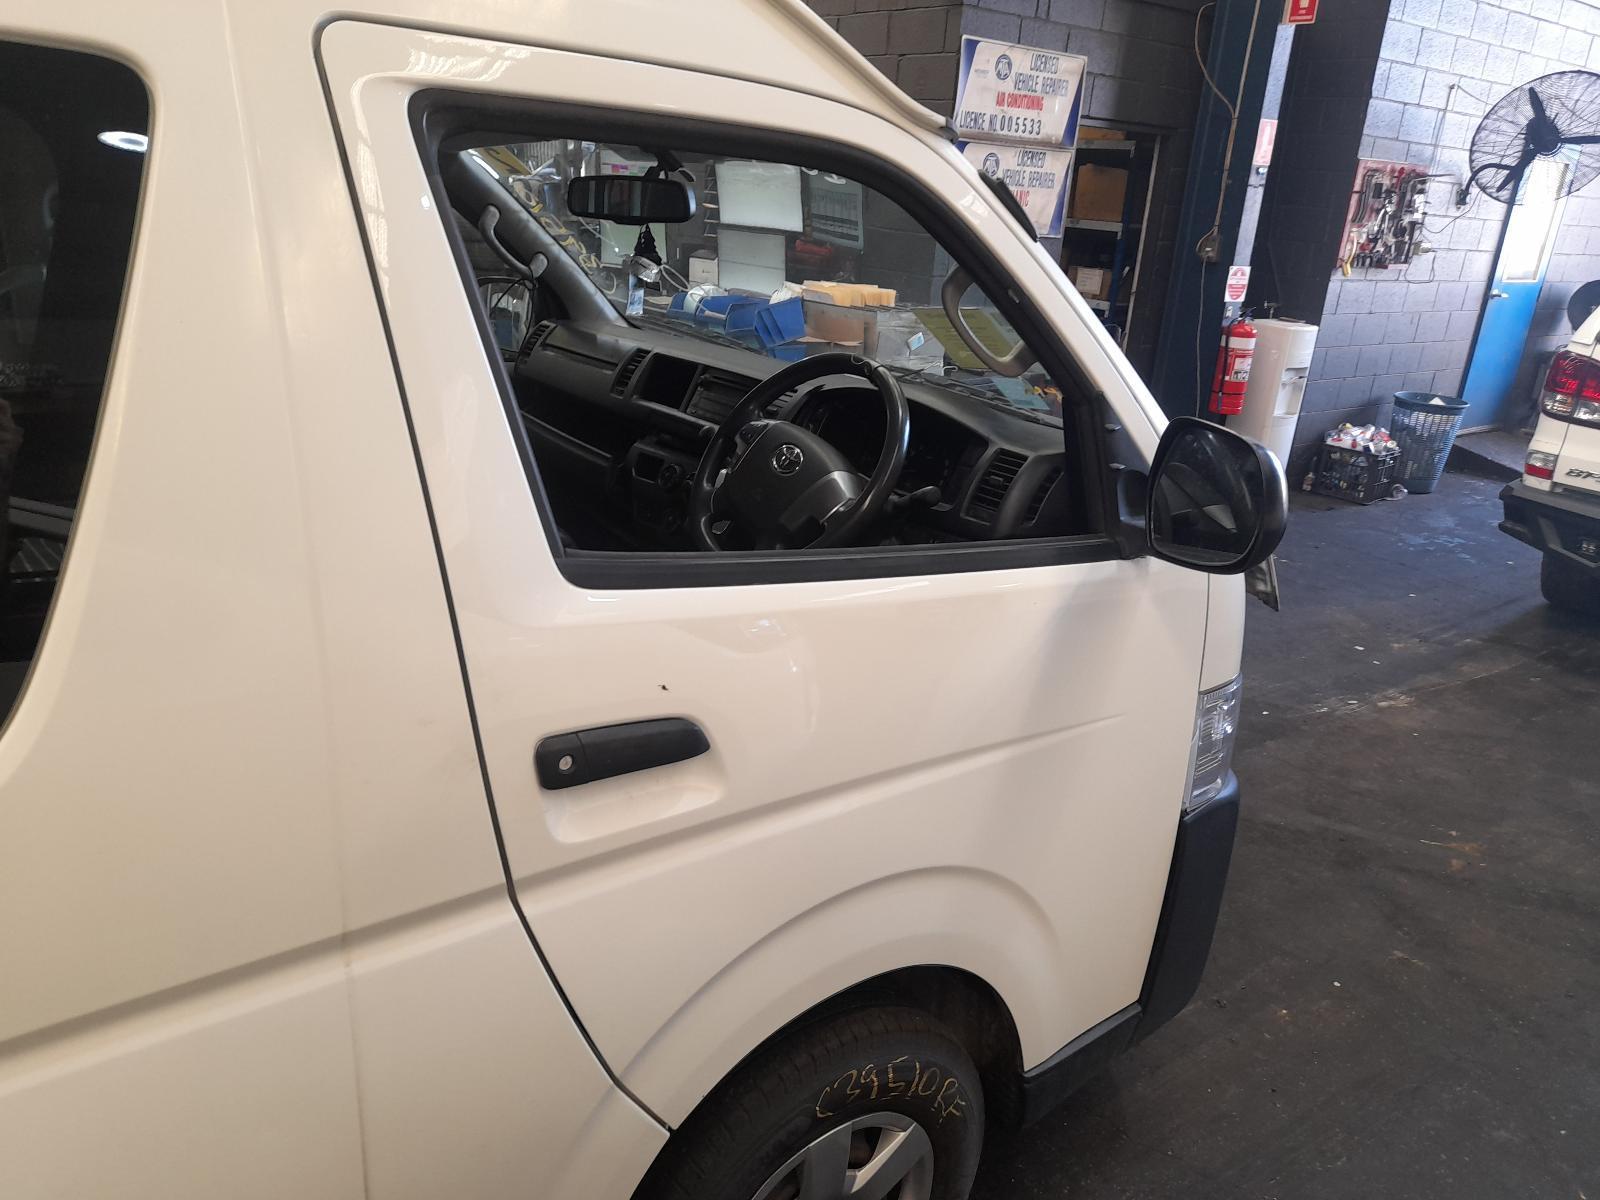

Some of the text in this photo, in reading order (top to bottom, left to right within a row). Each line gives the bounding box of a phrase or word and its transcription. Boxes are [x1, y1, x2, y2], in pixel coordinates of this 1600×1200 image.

[1030, 53, 1059, 74] LICENSED
[1014, 72, 1069, 96] VEHICLE REPAIRER
[996, 91, 1044, 111] AIR CONDITIONING
[959, 110, 986, 131] LICENCE
[999, 114, 1042, 135] 005533
[1017, 149, 1047, 168] LICENSED
[1027, 170, 1056, 189] REPAIRER
